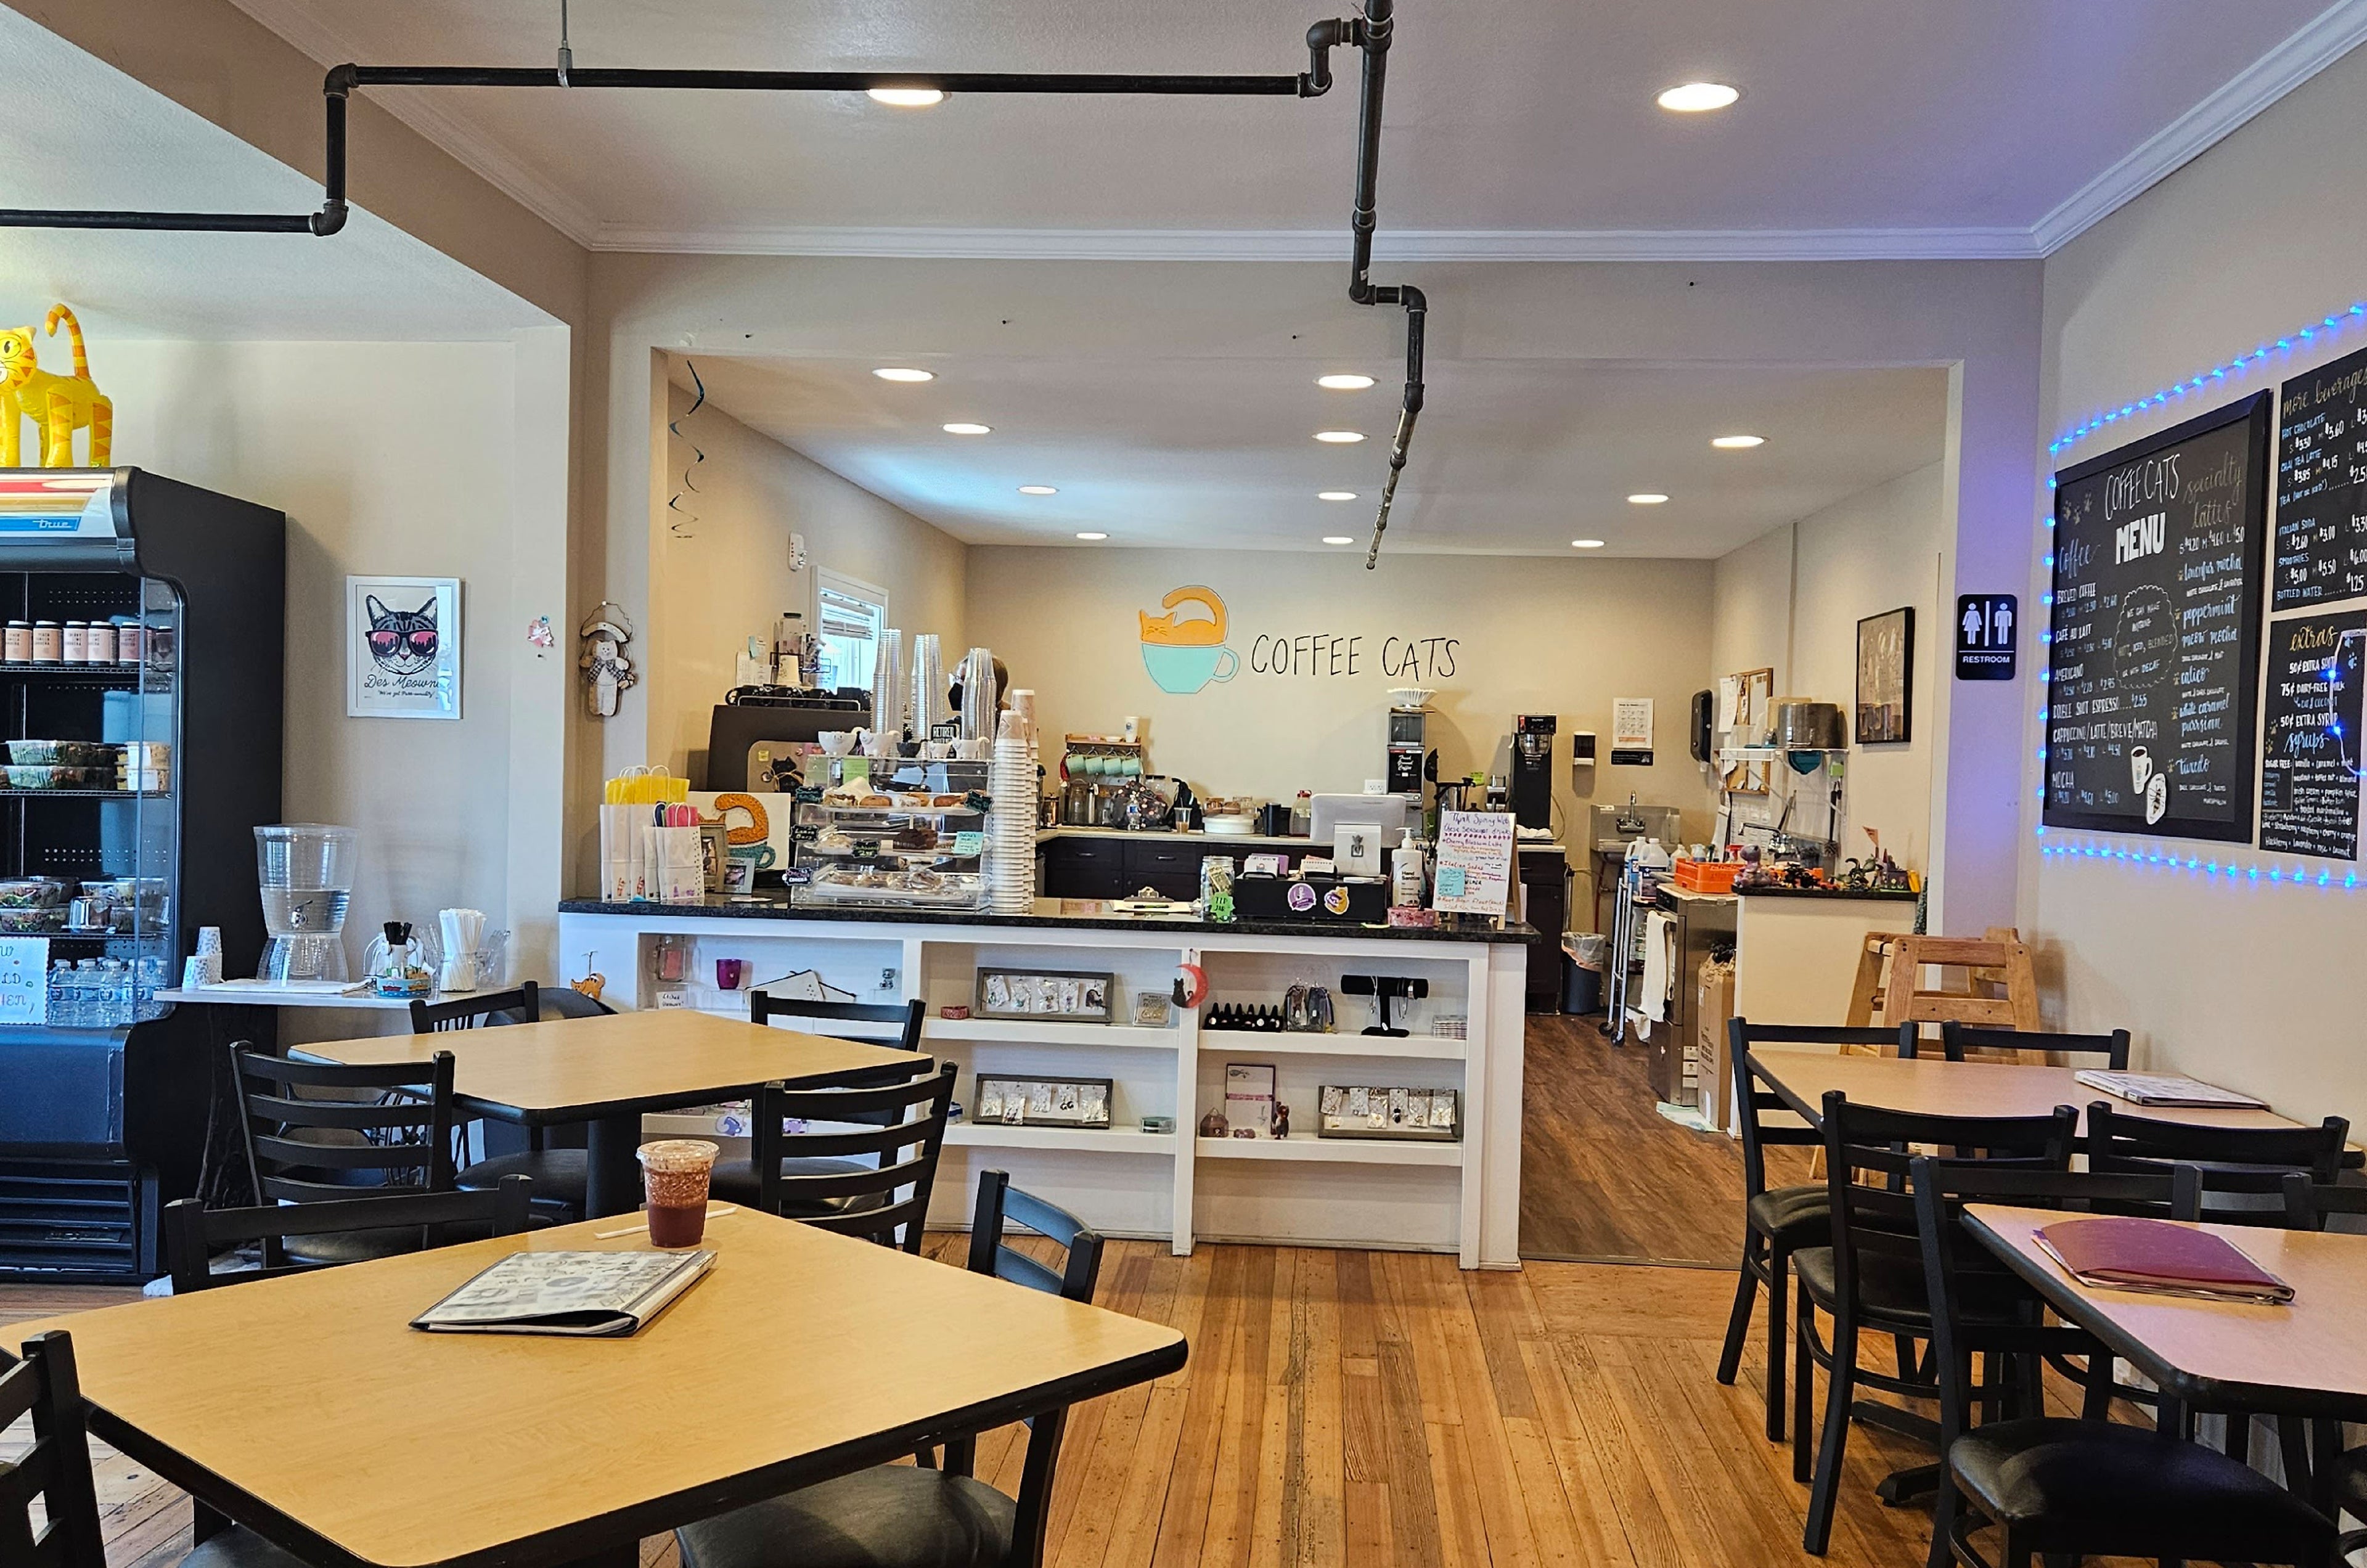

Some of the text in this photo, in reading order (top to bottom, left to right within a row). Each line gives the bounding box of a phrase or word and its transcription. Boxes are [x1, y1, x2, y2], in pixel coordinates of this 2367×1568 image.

[2105, 453, 2180, 521] COFFEE CATS
[32, 518, 73, 529] true
[2116, 512, 2165, 565] MENU
[2289, 626, 2338, 651] extras
[1251, 634, 1460, 681] COFFEE CATS
[364, 674, 390, 688] Des
[2296, 714, 2315, 727] EXTRA
[933, 726, 954, 738] RETIRED
